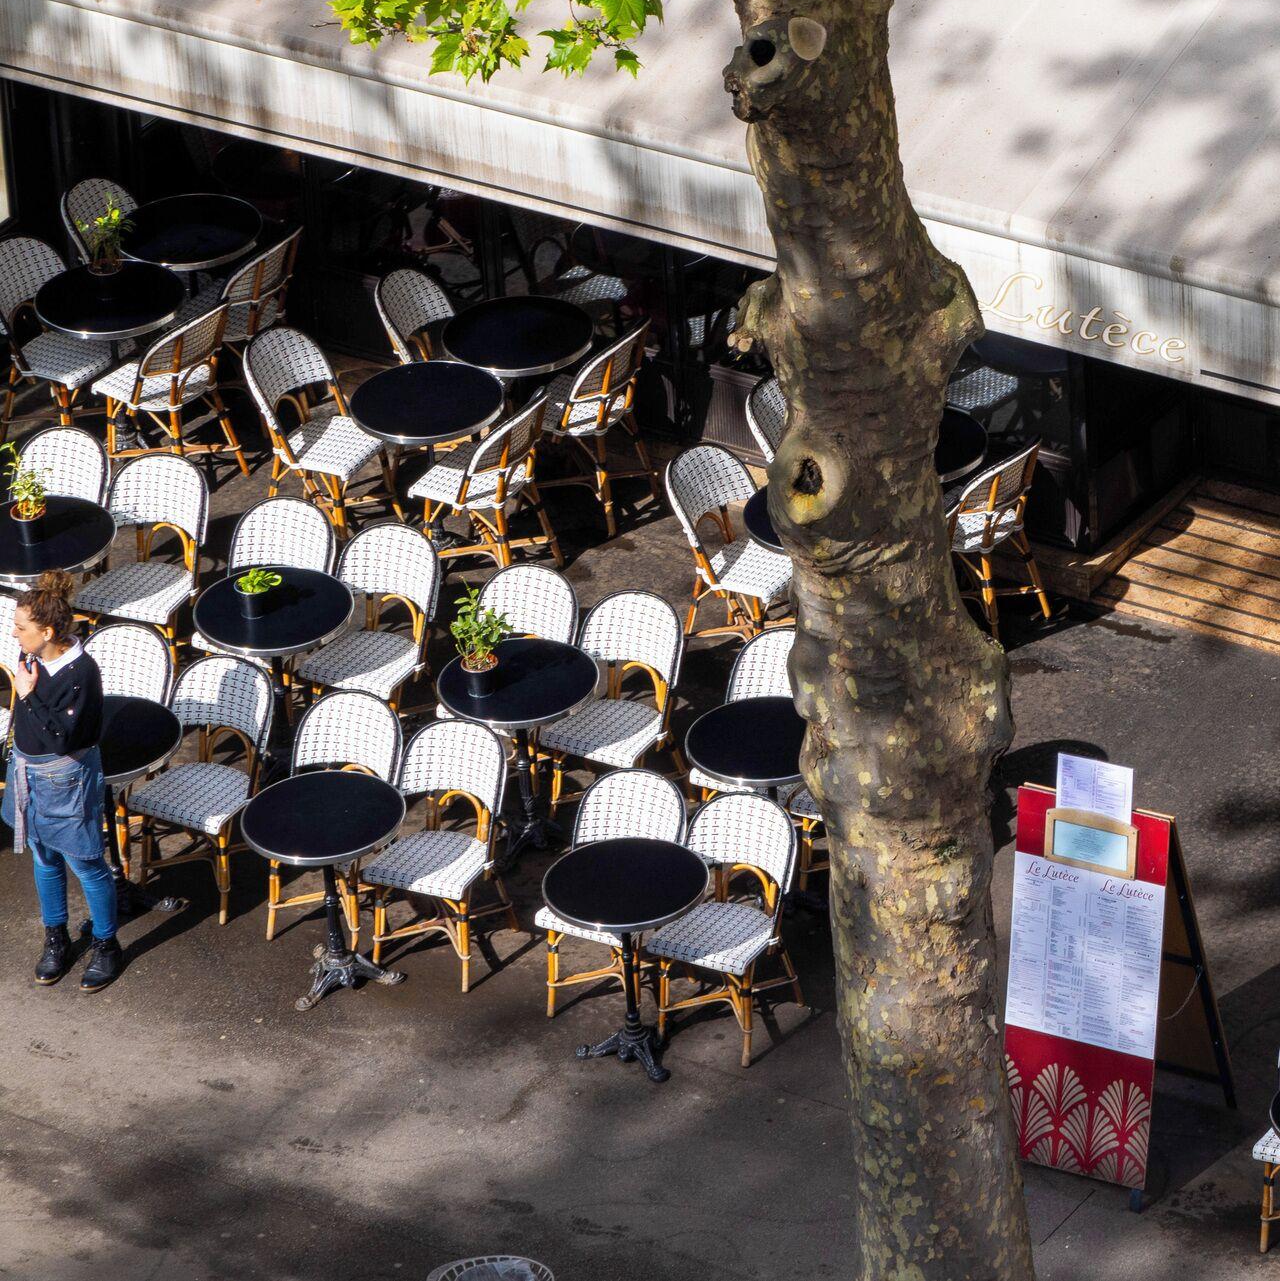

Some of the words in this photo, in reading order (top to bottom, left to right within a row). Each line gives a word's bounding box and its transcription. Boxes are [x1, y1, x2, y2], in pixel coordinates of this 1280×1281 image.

[978, 272, 1187, 363] Lutèce
[1026, 860, 1041, 877] Le
[1042, 864, 1080, 883] Lutèce
[1100, 878, 1117, 896] Le
[1117, 882, 1154, 901] Lutèce
